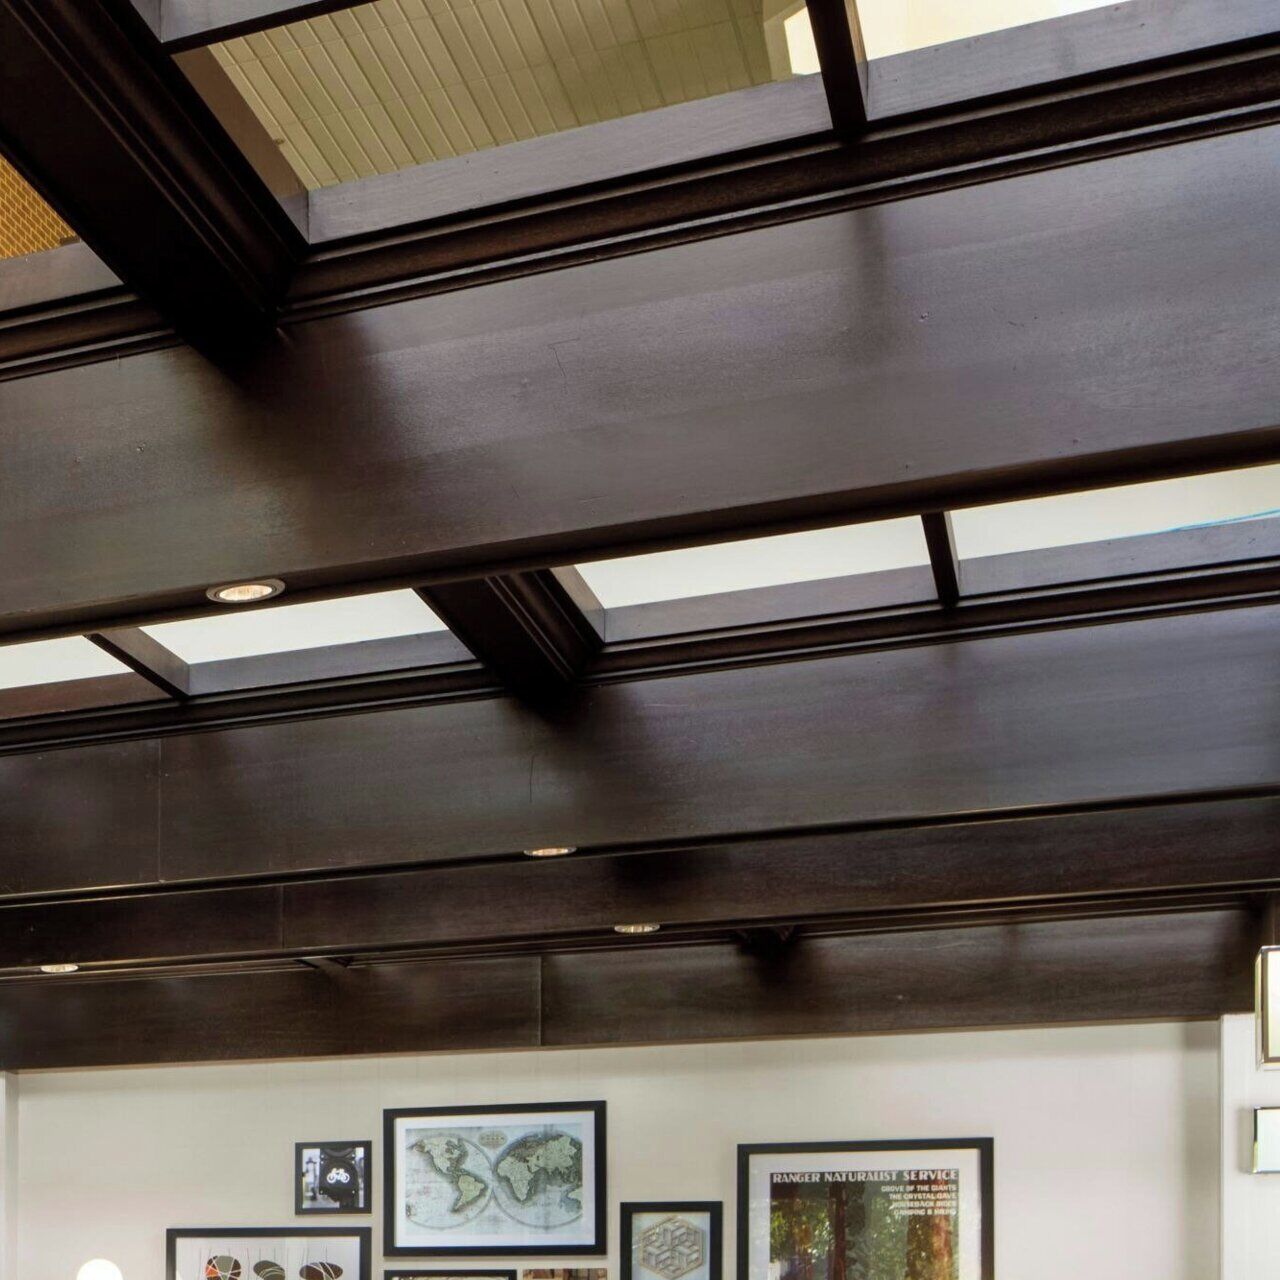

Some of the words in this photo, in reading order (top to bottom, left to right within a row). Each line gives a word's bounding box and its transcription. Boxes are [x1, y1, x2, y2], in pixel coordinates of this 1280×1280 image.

[773, 1172, 820, 1184] RANGER
[824, 1170, 898, 1183] NATURALIST
[903, 1169, 958, 1181] SERVICE
[917, 1184, 929, 1192] THE
[889, 1192, 902, 1200] THE
